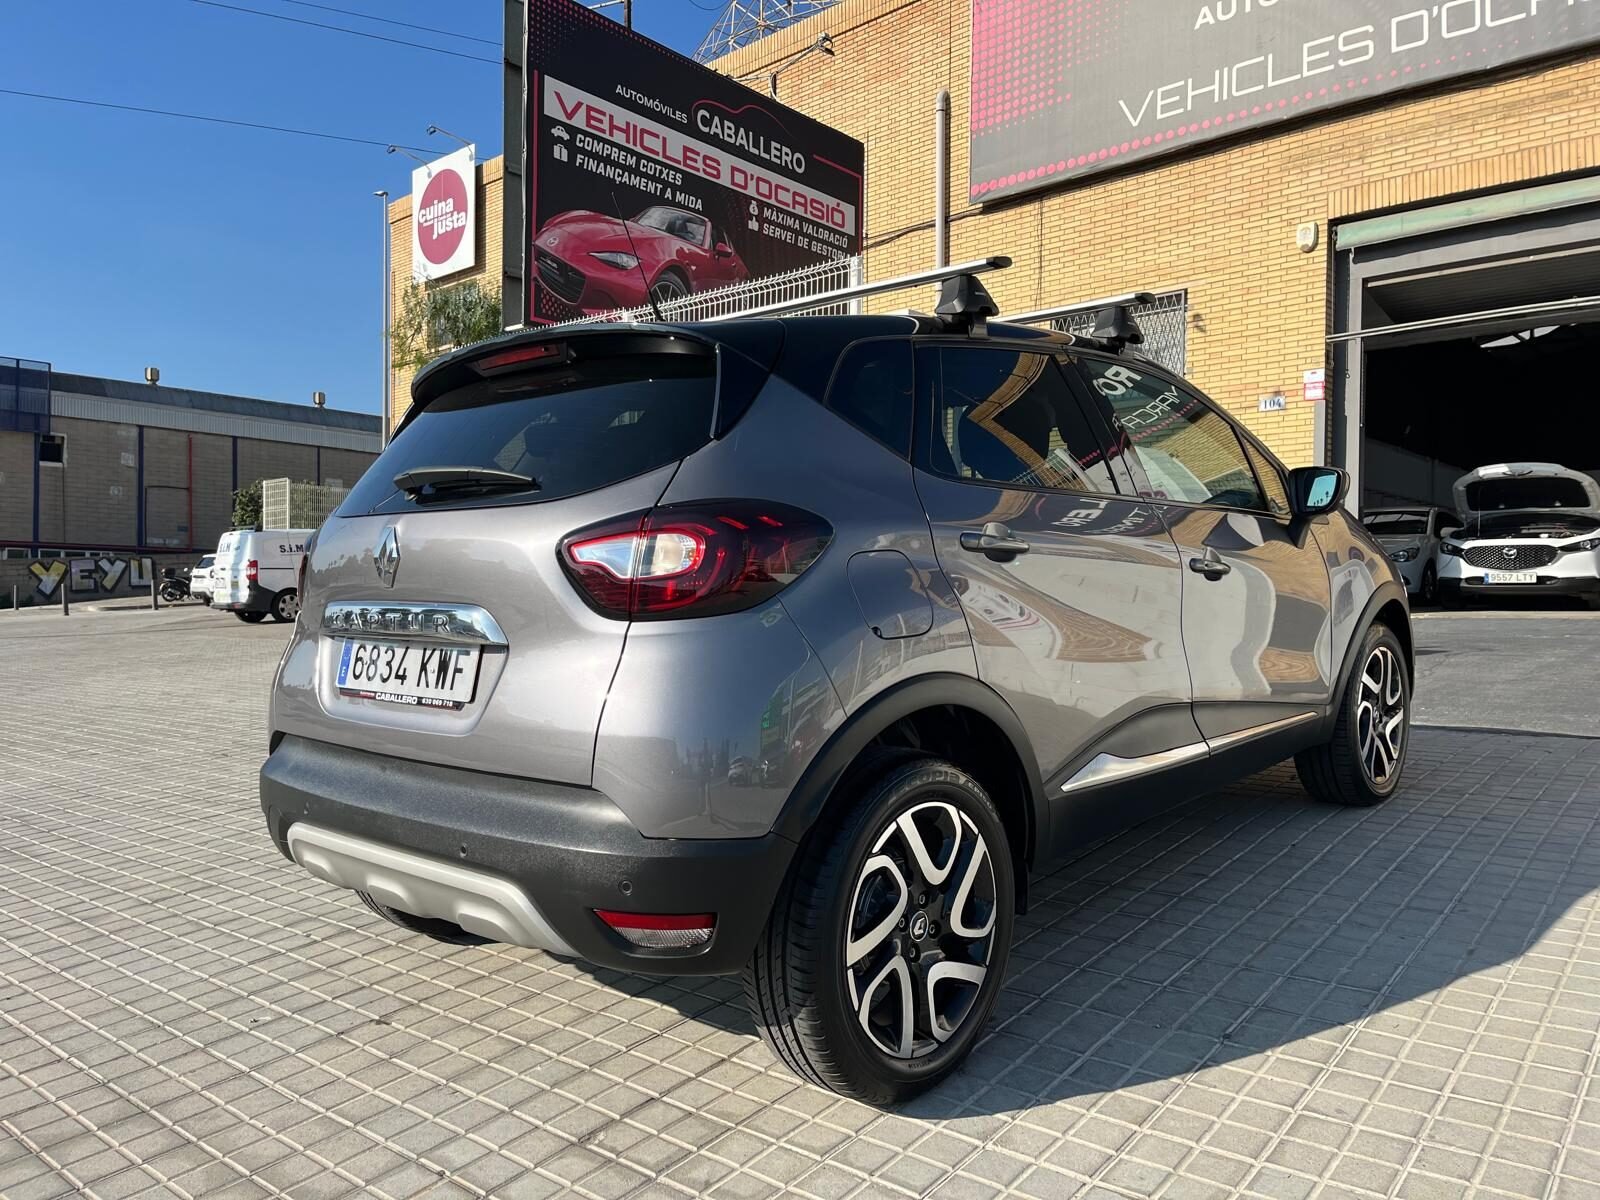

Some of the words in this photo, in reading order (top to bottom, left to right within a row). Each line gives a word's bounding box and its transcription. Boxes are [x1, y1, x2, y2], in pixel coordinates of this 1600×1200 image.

[1118, 24, 1375, 128] VEHICLES
[615, 84, 688, 124] AUTOMÓVILES
[553, 90, 722, 181] VEHICLES
[730, 164, 846, 229] D'OCASIÓ
[575, 133, 637, 169] COMPREM
[639, 158, 683, 186] COTXES
[696, 109, 806, 174] CABALLERO
[575, 153, 663, 196] FINANÇAMENT
[664, 187, 673, 201] A
[675, 190, 703, 212] MIDA
[418, 197, 455, 224] cuina
[432, 211, 467, 240] justa
[763, 207, 800, 231] MÀXIMA
[802, 221, 848, 249] VALORACIÓ
[762, 223, 796, 245] SERVEI
[797, 236, 809, 250] DE
[1263, 398, 1283, 410] 104
[28, 555, 154, 598] YEYU
[1490, 573, 1514, 582] 9557
[1516, 573, 1535, 582] LTY
[332, 612, 450, 633] CAPTUR
[352, 643, 411, 686] 6834
[416, 646, 472, 691] KWF
[375, 692, 418, 705] CABALLERO
